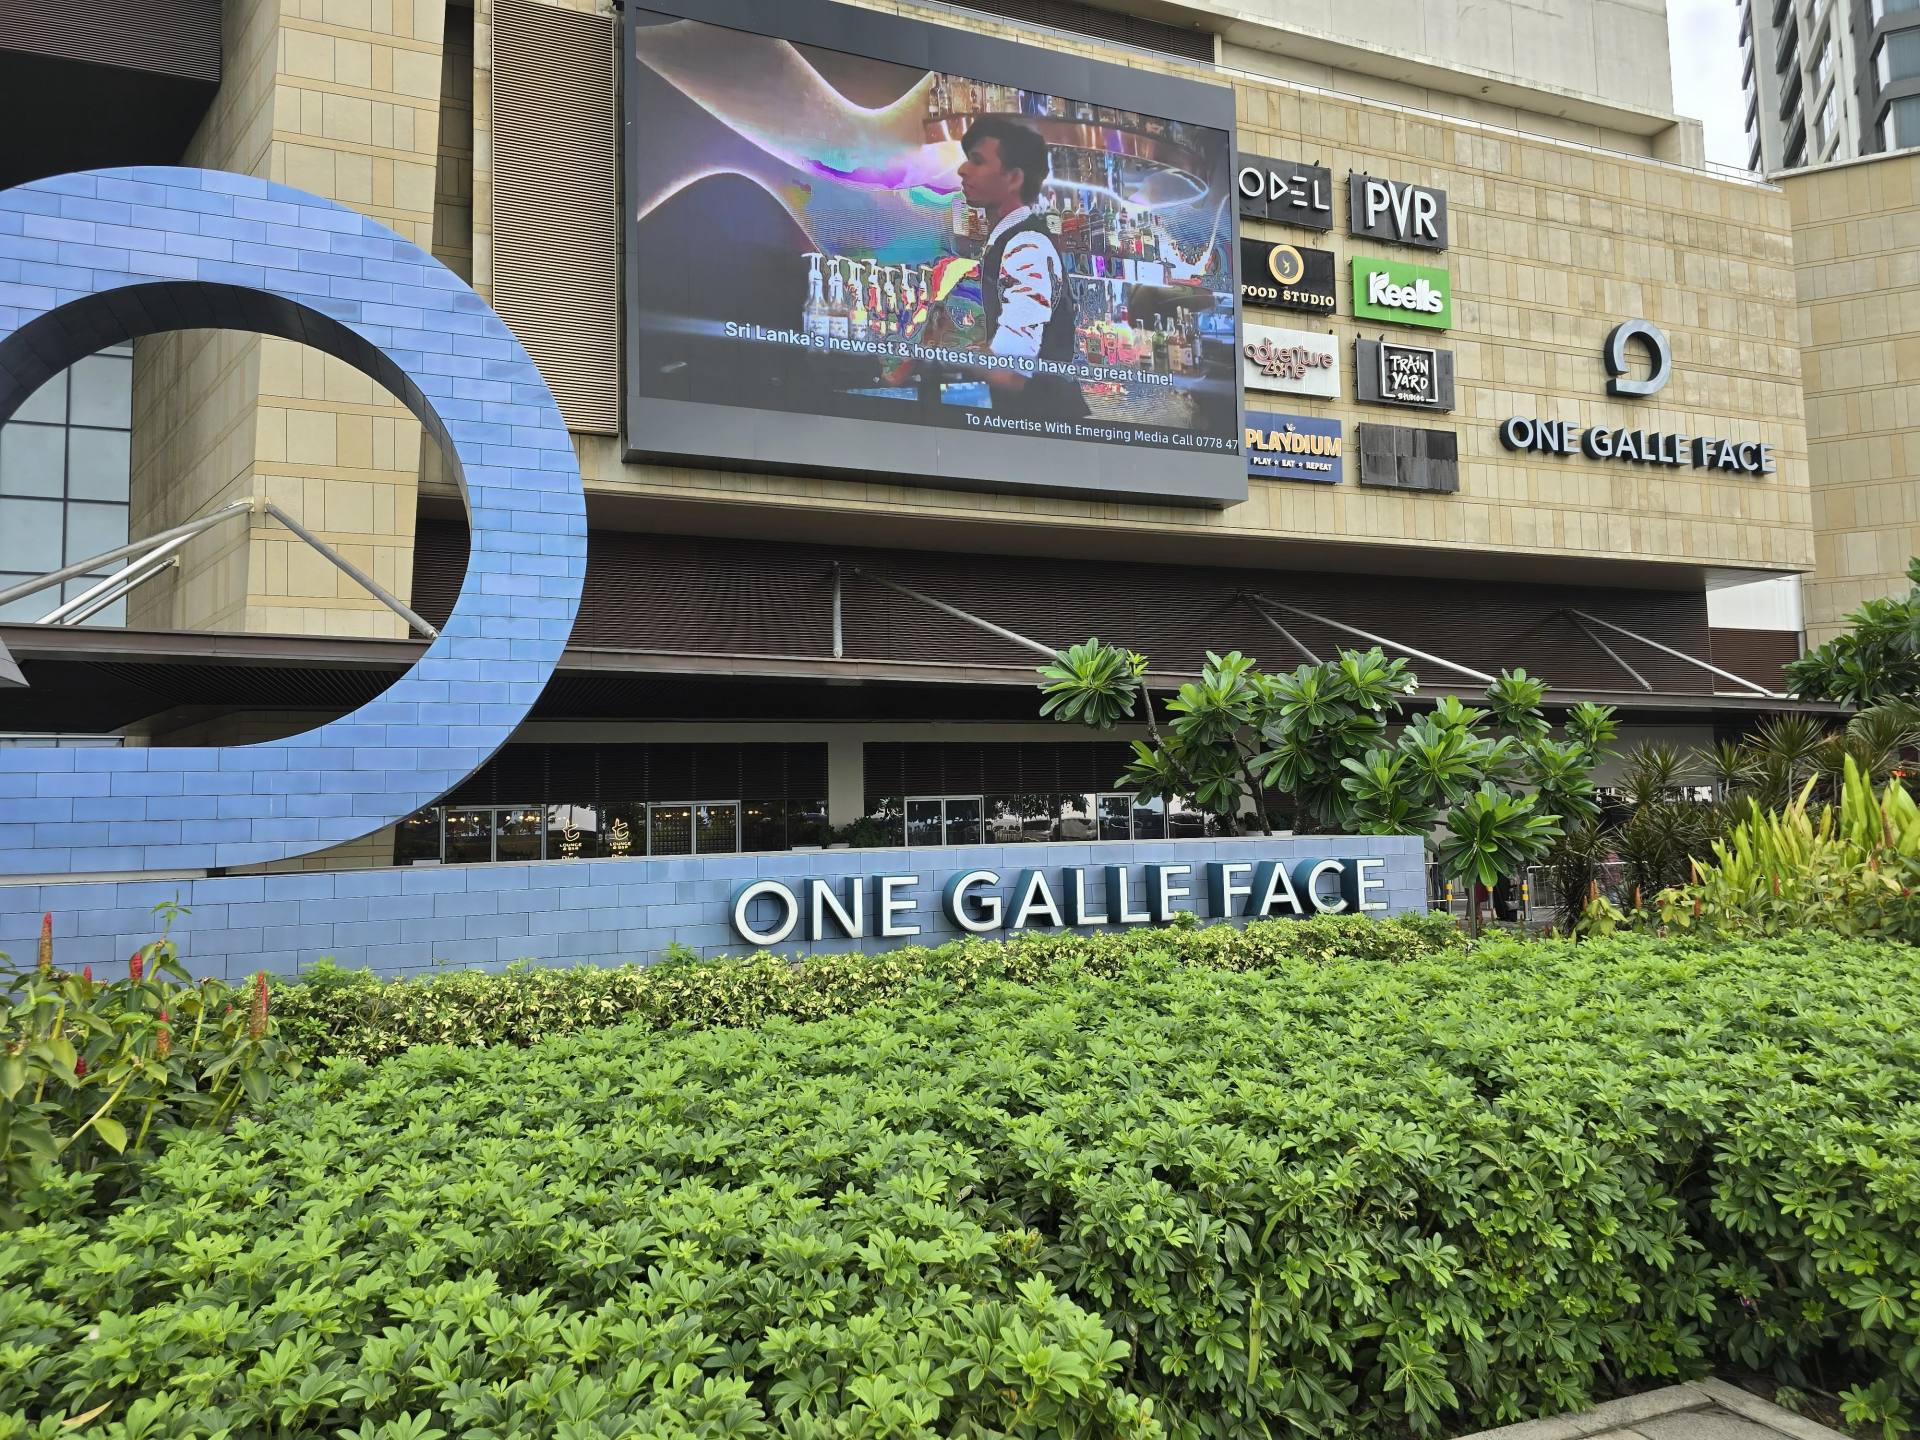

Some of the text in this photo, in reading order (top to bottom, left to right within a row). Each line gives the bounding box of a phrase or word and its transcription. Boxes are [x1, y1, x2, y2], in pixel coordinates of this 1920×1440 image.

[1238, 167, 1330, 211] ODEL
[1365, 179, 1438, 239] PVR
[1241, 284, 1335, 307] FOOD STUDIO
[1368, 271, 1443, 313] Keells
[725, 322, 1173, 386] Sri Lanka's newest & hottest spot to have a great time!
[1243, 337, 1334, 369] adventure
[1262, 359, 1307, 379] zone
[1392, 371, 1429, 393] YARD
[965, 413, 1238, 450] To Advertise With Emerging Media Call 0778 47
[1244, 428, 1342, 457] PLAYDIUM
[1504, 416, 1777, 474] ONE GALLE FACE
[1253, 456, 1332, 471] PLAY EAT REPEAT
[731, 858, 1388, 945] ONE GALLE FACE
